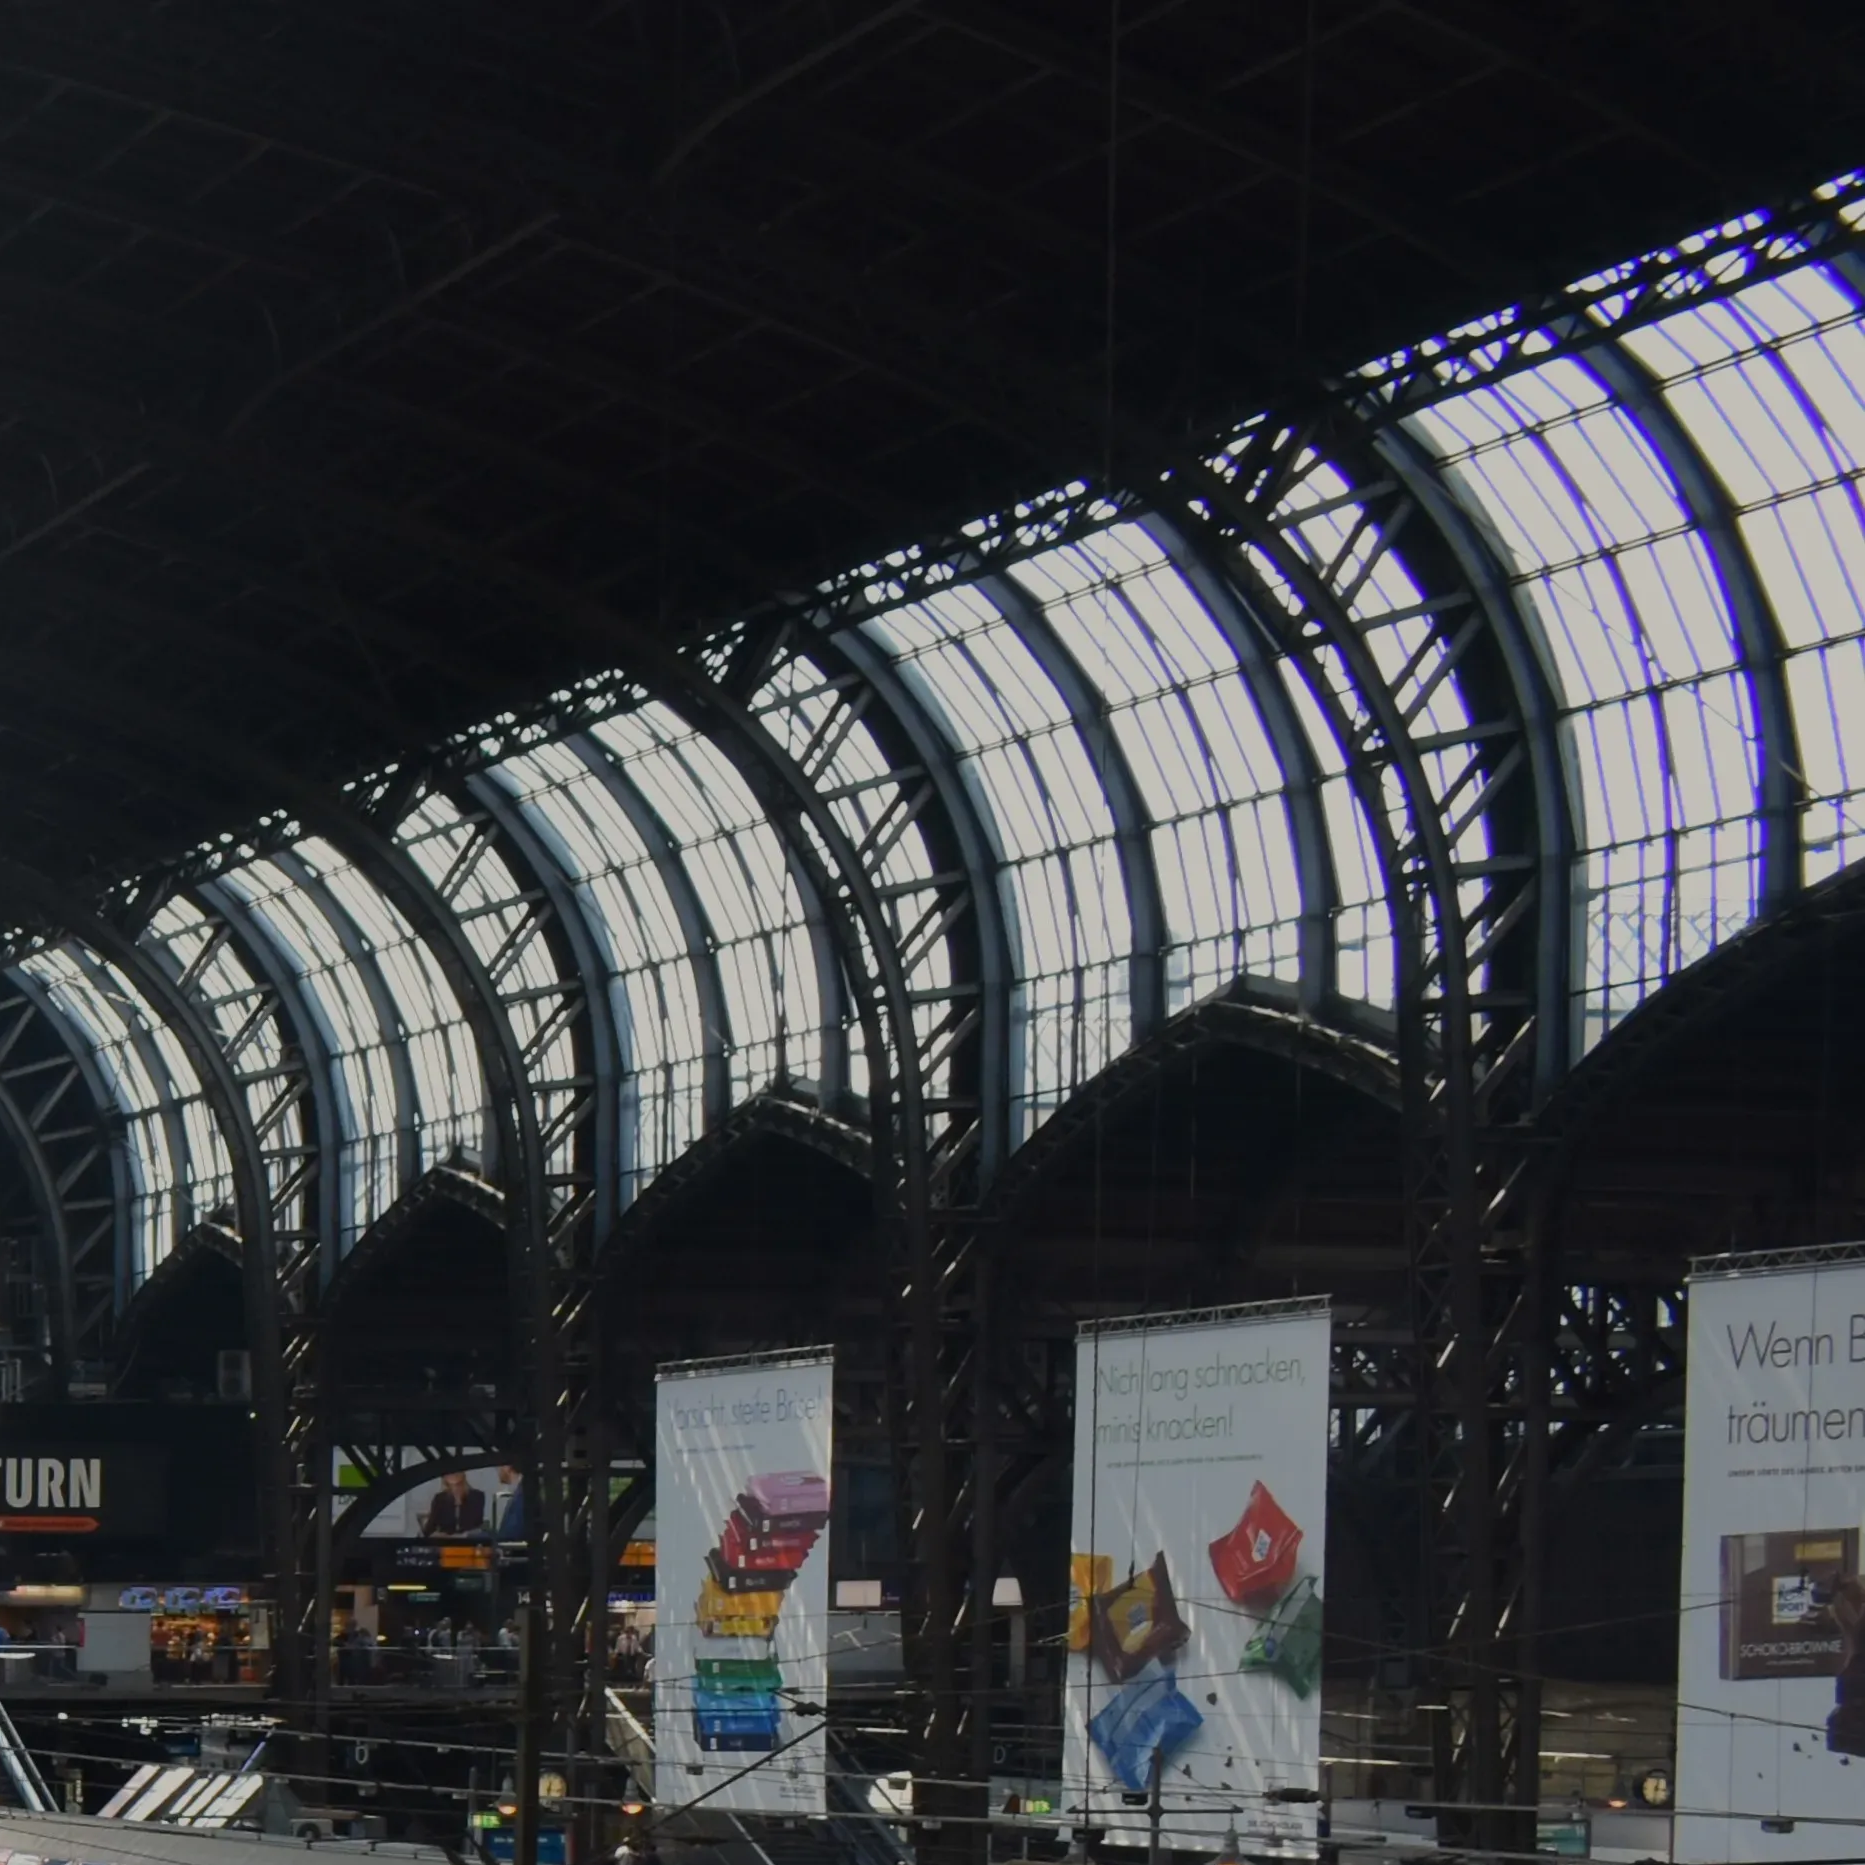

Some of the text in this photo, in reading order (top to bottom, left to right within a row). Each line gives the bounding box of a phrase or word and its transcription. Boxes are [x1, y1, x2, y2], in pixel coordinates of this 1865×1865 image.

[1726, 1320, 1834, 1369] Wenn
[1147, 1358, 1188, 1402] lang
[1194, 1346, 1306, 1390] schnacken,
[1145, 1402, 1235, 1444] knacken!
[1726, 1400, 1865, 1445] träumen
[993, 1744, 1006, 1764] D
